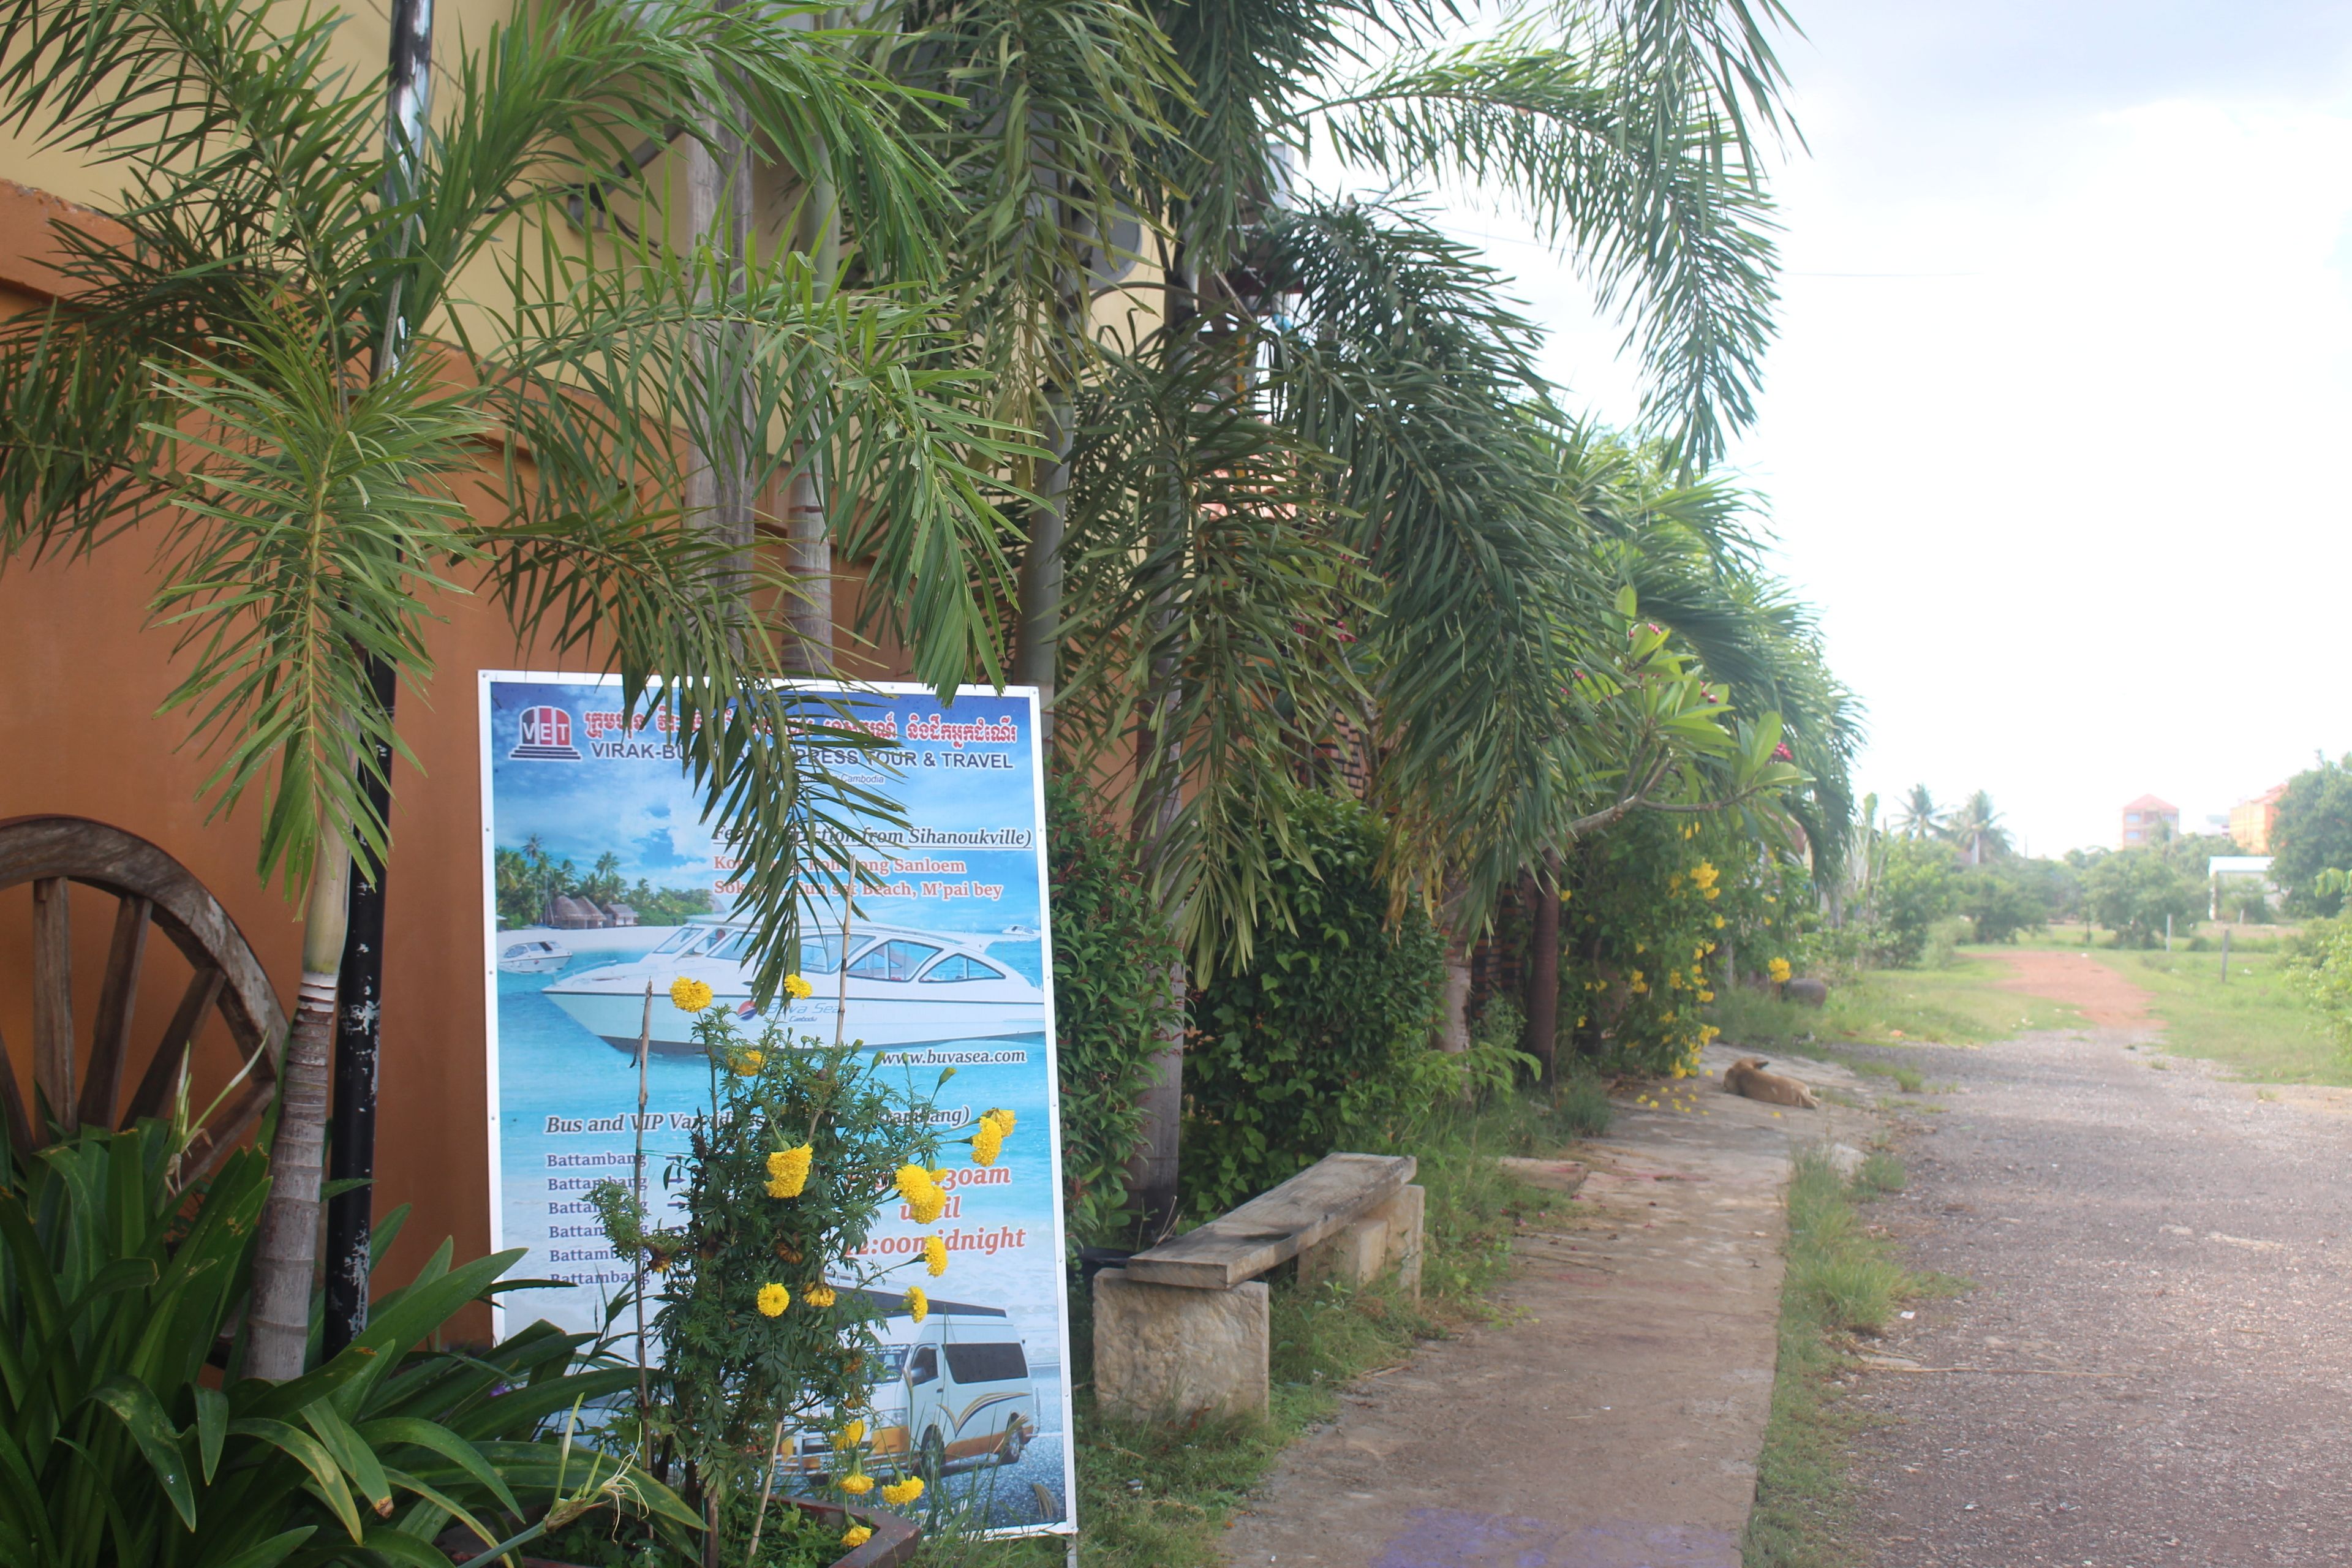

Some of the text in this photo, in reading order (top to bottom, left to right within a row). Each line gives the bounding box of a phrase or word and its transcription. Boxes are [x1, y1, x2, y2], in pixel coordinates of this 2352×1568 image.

[522, 722, 568, 742] VET
[924, 752, 936, 767] &
[941, 753, 1014, 768] TRAVEL
[842, 773, 884, 783] Cambodia
[909, 827, 1031, 848] Sihanoukville)
[895, 858, 965, 872] Sanloem
[832, 883, 857, 895] st
[862, 883, 917, 898] Beach,
[973, 883, 1002, 899] bey
[767, 1002, 808, 1014] Bva
[883, 1049, 1025, 1063] www.buvasea.com
[546, 1116, 582, 1133] Bus
[588, 1114, 625, 1131] and
[630, 1114, 664, 1131] VIP
[900, 1196, 960, 1221] uil
